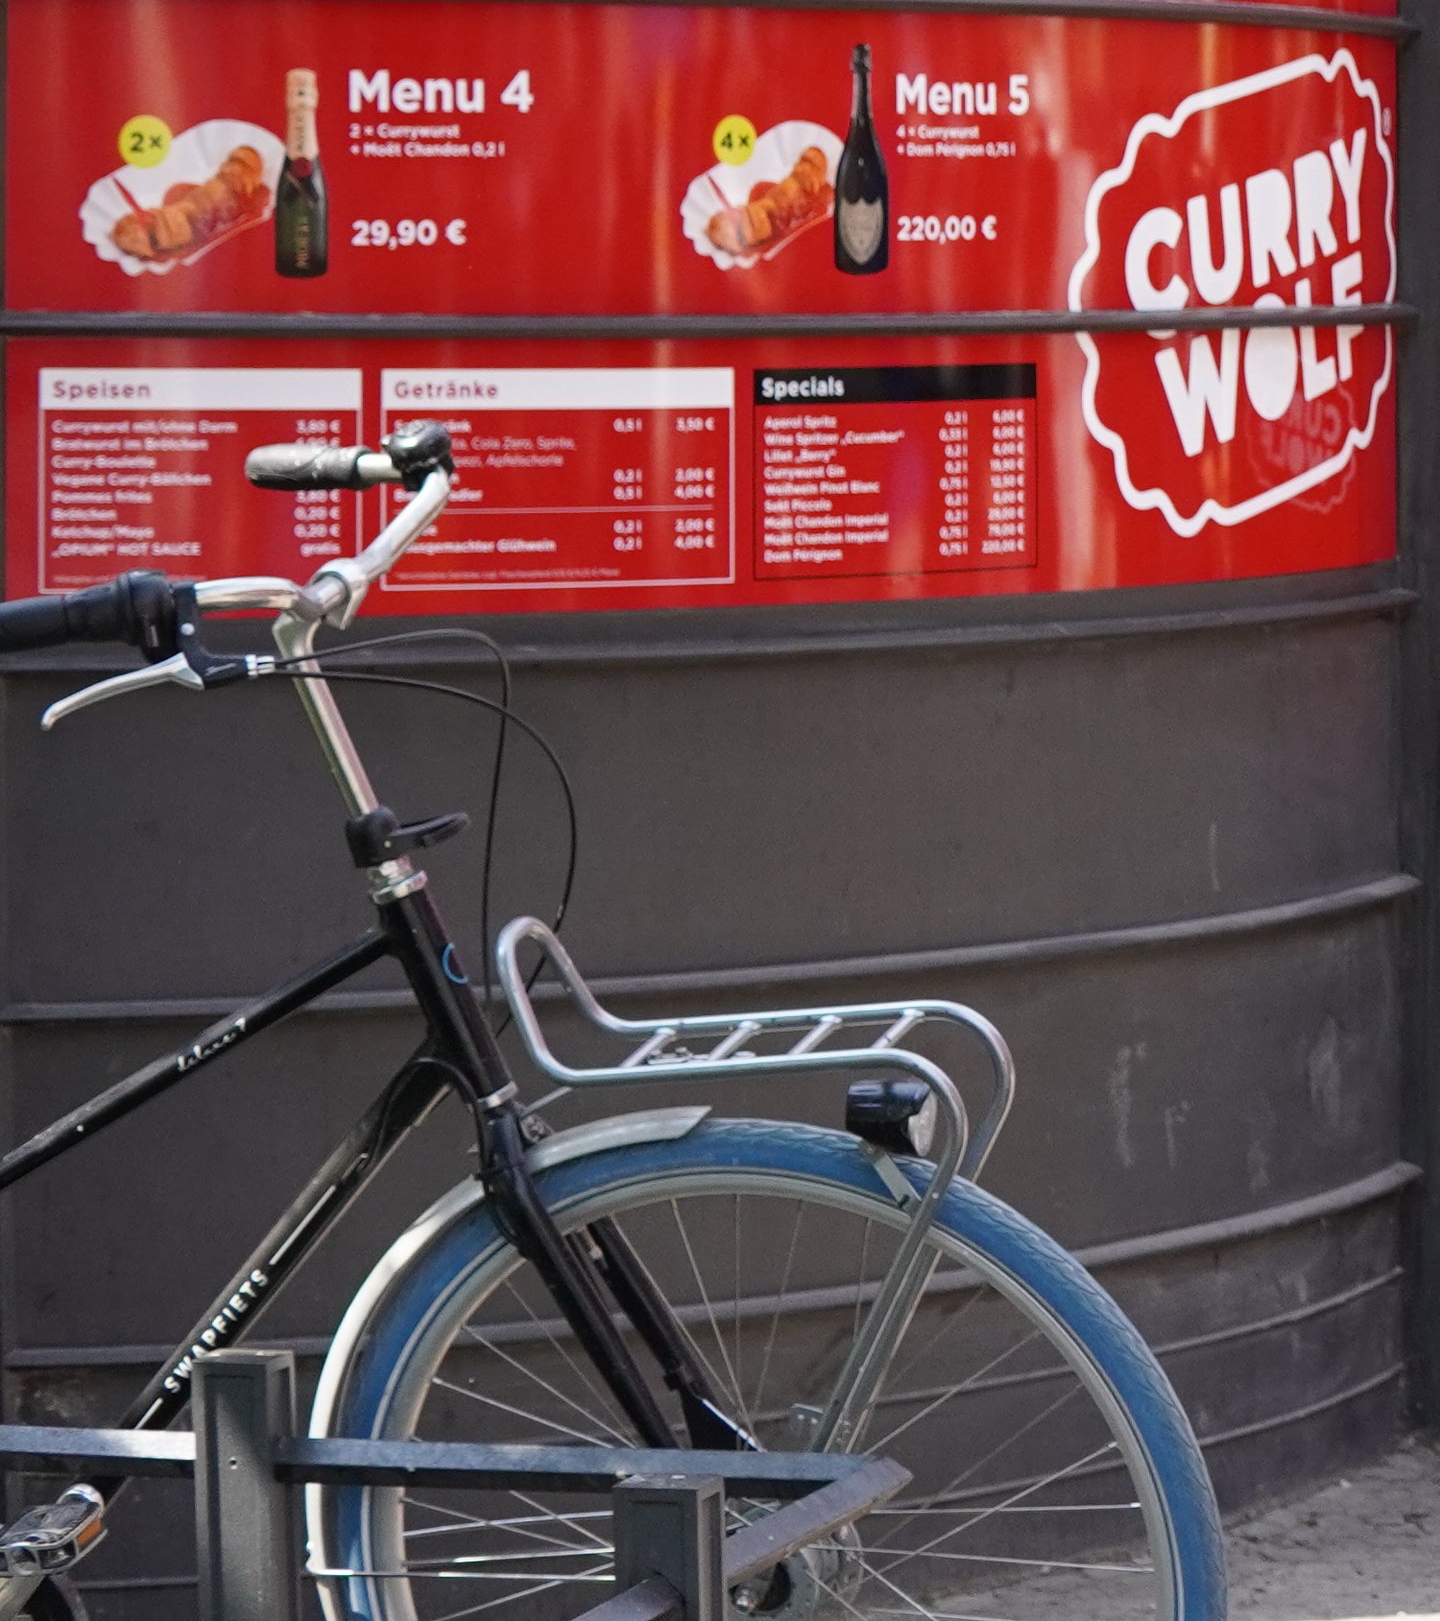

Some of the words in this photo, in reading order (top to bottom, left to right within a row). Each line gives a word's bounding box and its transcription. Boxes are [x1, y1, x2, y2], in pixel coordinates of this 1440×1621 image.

[348, 69, 486, 114] Menu
[500, 70, 534, 114] 4
[895, 73, 997, 115] Menu
[1008, 74, 1030, 116] 5
[377, 124, 460, 141] Currywurst
[404, 142, 469, 158] Chandon
[351, 219, 437, 249] 29,90
[445, 219, 466, 246] €
[897, 216, 977, 245] 220,00
[981, 215, 997, 241] €
[1125, 127, 1367, 340] CURRY
[1155, 251, 1364, 458] WOLF
[53, 380, 150, 400] Speisen
[394, 381, 498, 399] Getränke
[762, 376, 845, 400] Specials
[164, 1268, 269, 1394] SWAPFIETS
